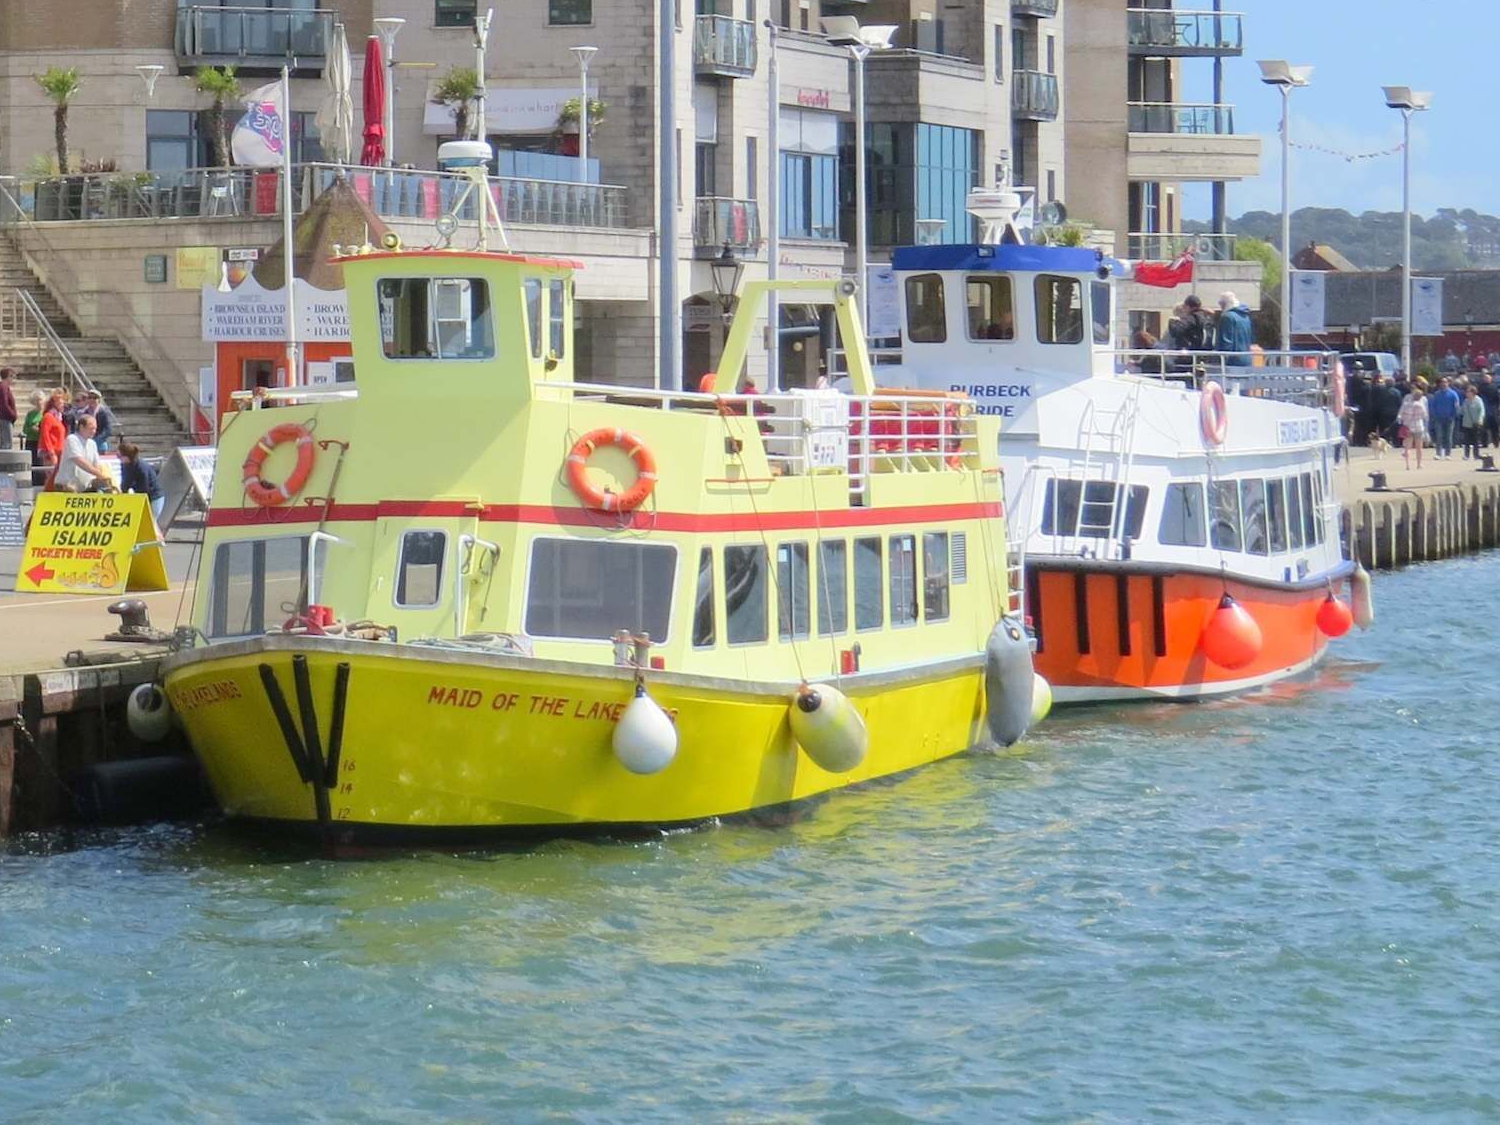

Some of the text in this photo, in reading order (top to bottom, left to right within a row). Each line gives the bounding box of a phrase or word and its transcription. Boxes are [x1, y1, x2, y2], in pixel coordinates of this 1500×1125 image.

[214, 304, 286, 314] BROWNSEA ISLAND
[216, 316, 284, 325] WAREHAM RIVER
[317, 316, 349, 325] WARE
[214, 327, 252, 336] HARBOUR
[976, 406, 1014, 417] RIDE
[65, 497, 114, 509] FERRY TO
[40, 512, 131, 527] BROWNSEA
[51, 531, 113, 546] ISLAND
[31, 547, 105, 560] TICKETS HERE
[428, 686, 483, 709] MAID
[492, 693, 518, 711] OF
[530, 696, 569, 716] THE
